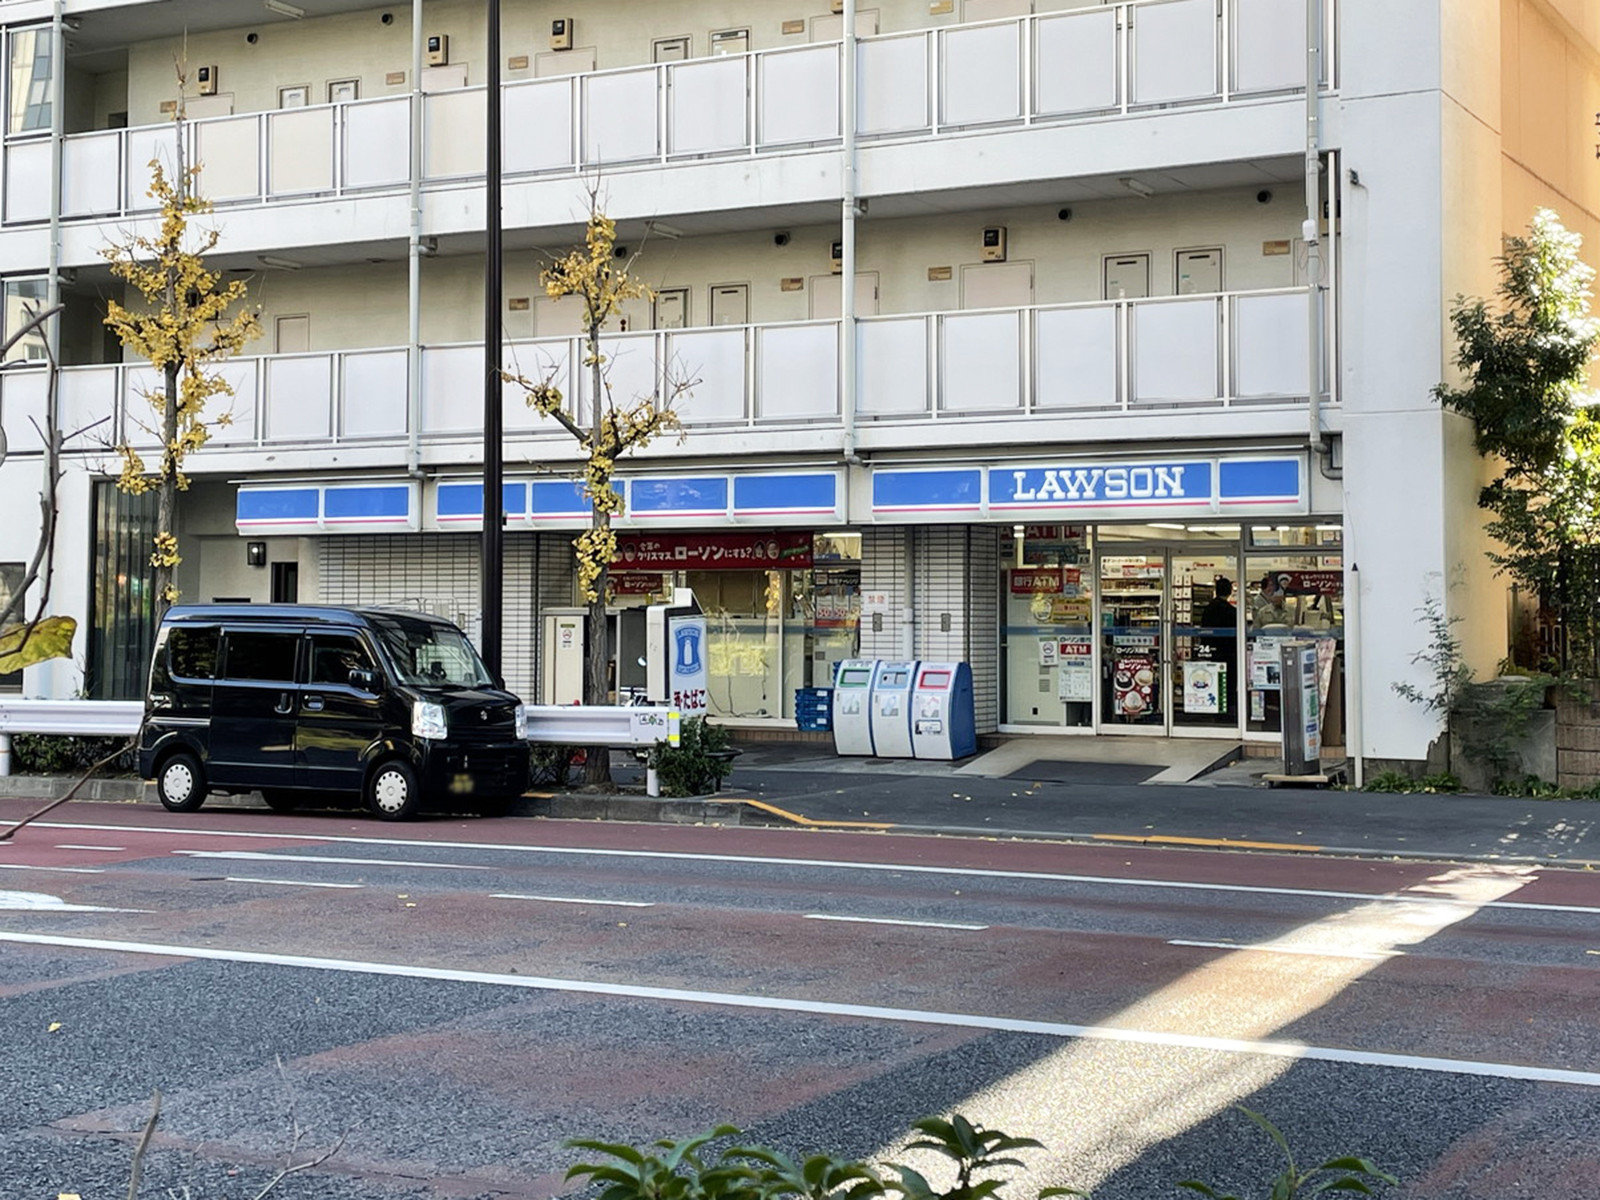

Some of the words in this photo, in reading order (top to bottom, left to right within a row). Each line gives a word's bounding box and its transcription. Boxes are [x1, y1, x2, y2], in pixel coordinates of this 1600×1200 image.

[1013, 466, 1185, 500] LAWSON
[1065, 644, 1087, 654] ATM
[1199, 645, 1210, 653] 24
